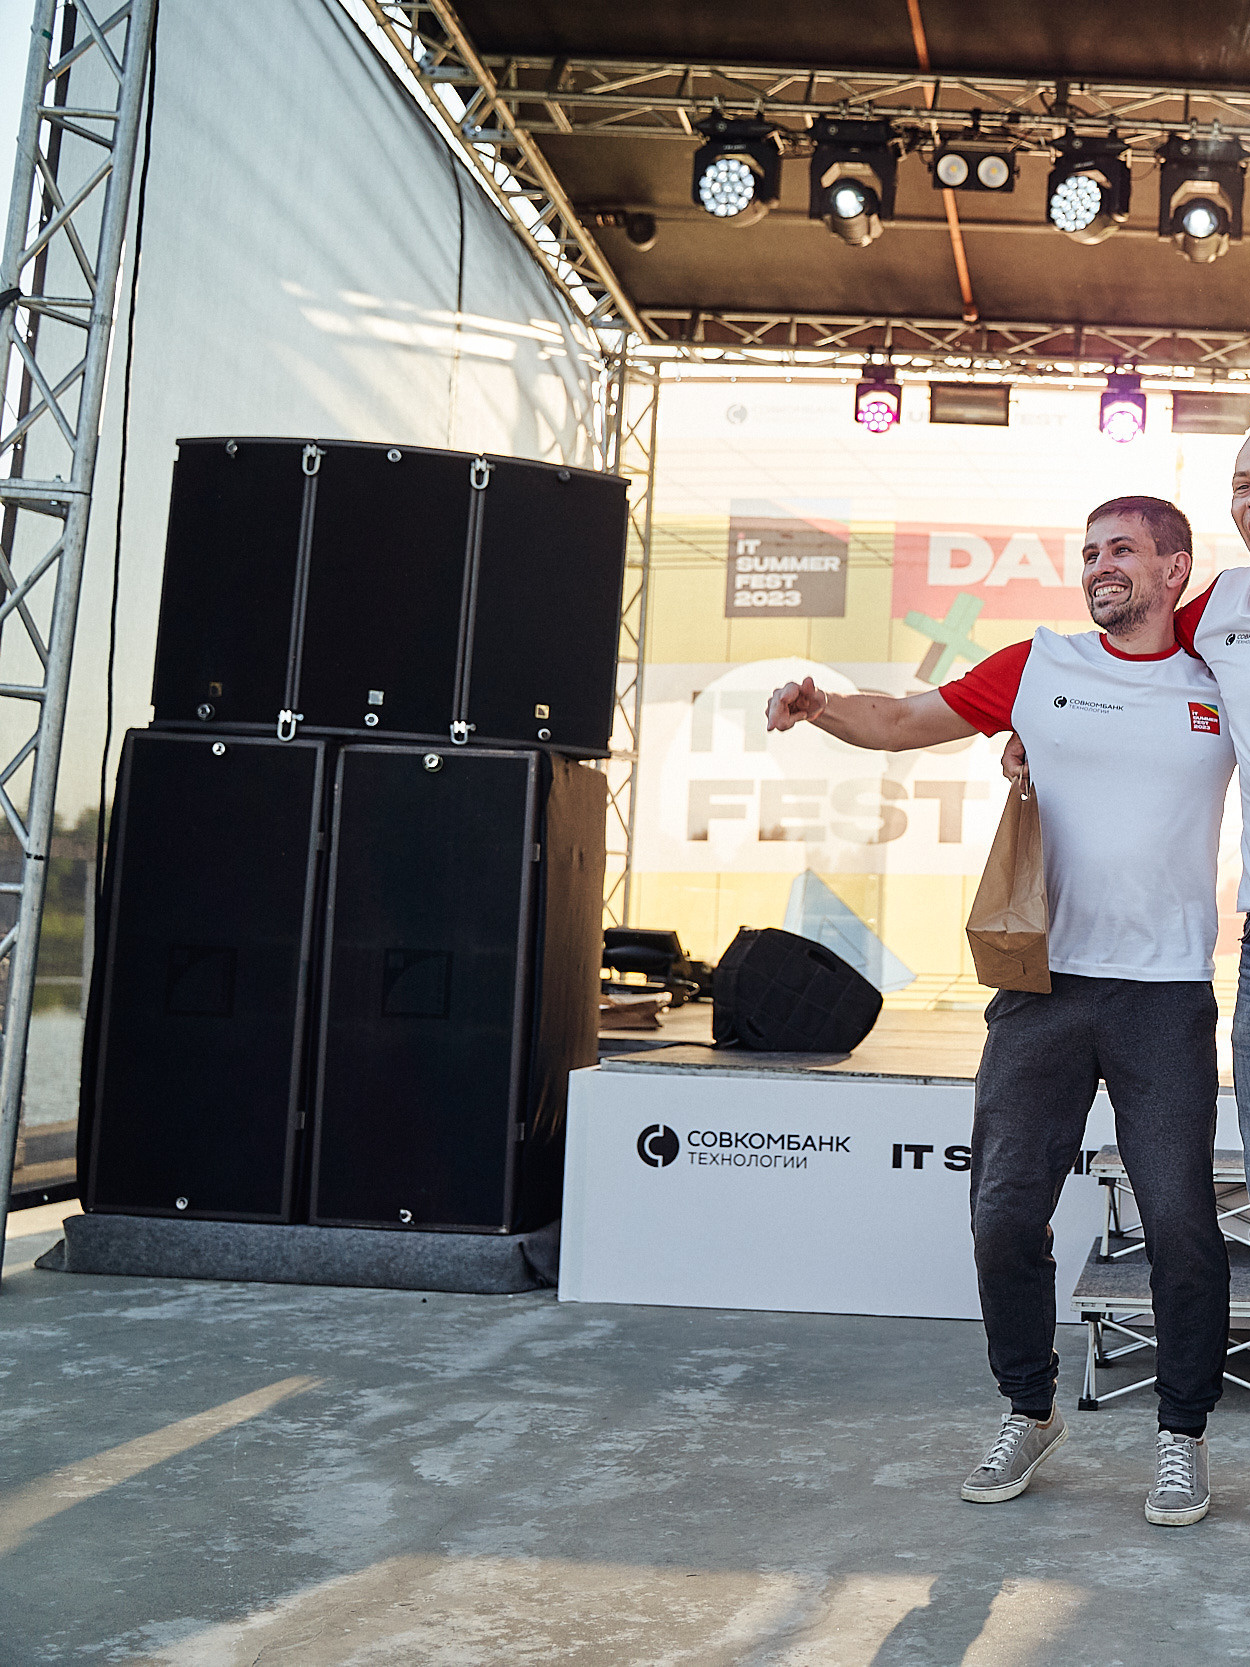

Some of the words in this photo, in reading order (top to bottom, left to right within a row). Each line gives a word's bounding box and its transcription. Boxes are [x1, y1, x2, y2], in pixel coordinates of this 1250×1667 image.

[735, 555, 841, 573] SUMMER
[734, 573, 799, 590] FEST
[733, 589, 802, 607] 2023
[1069, 698, 1125, 712] СОВКОМБАНК
[1069, 704, 1110, 714] ТЕХНОЛОГИИ
[687, 778, 989, 844] FEST
[687, 1130, 851, 1153] СОВКОМБАНК
[688, 1151, 808, 1170] ТЕХНОЛОГИИ
[892, 1143, 934, 1170] IT
